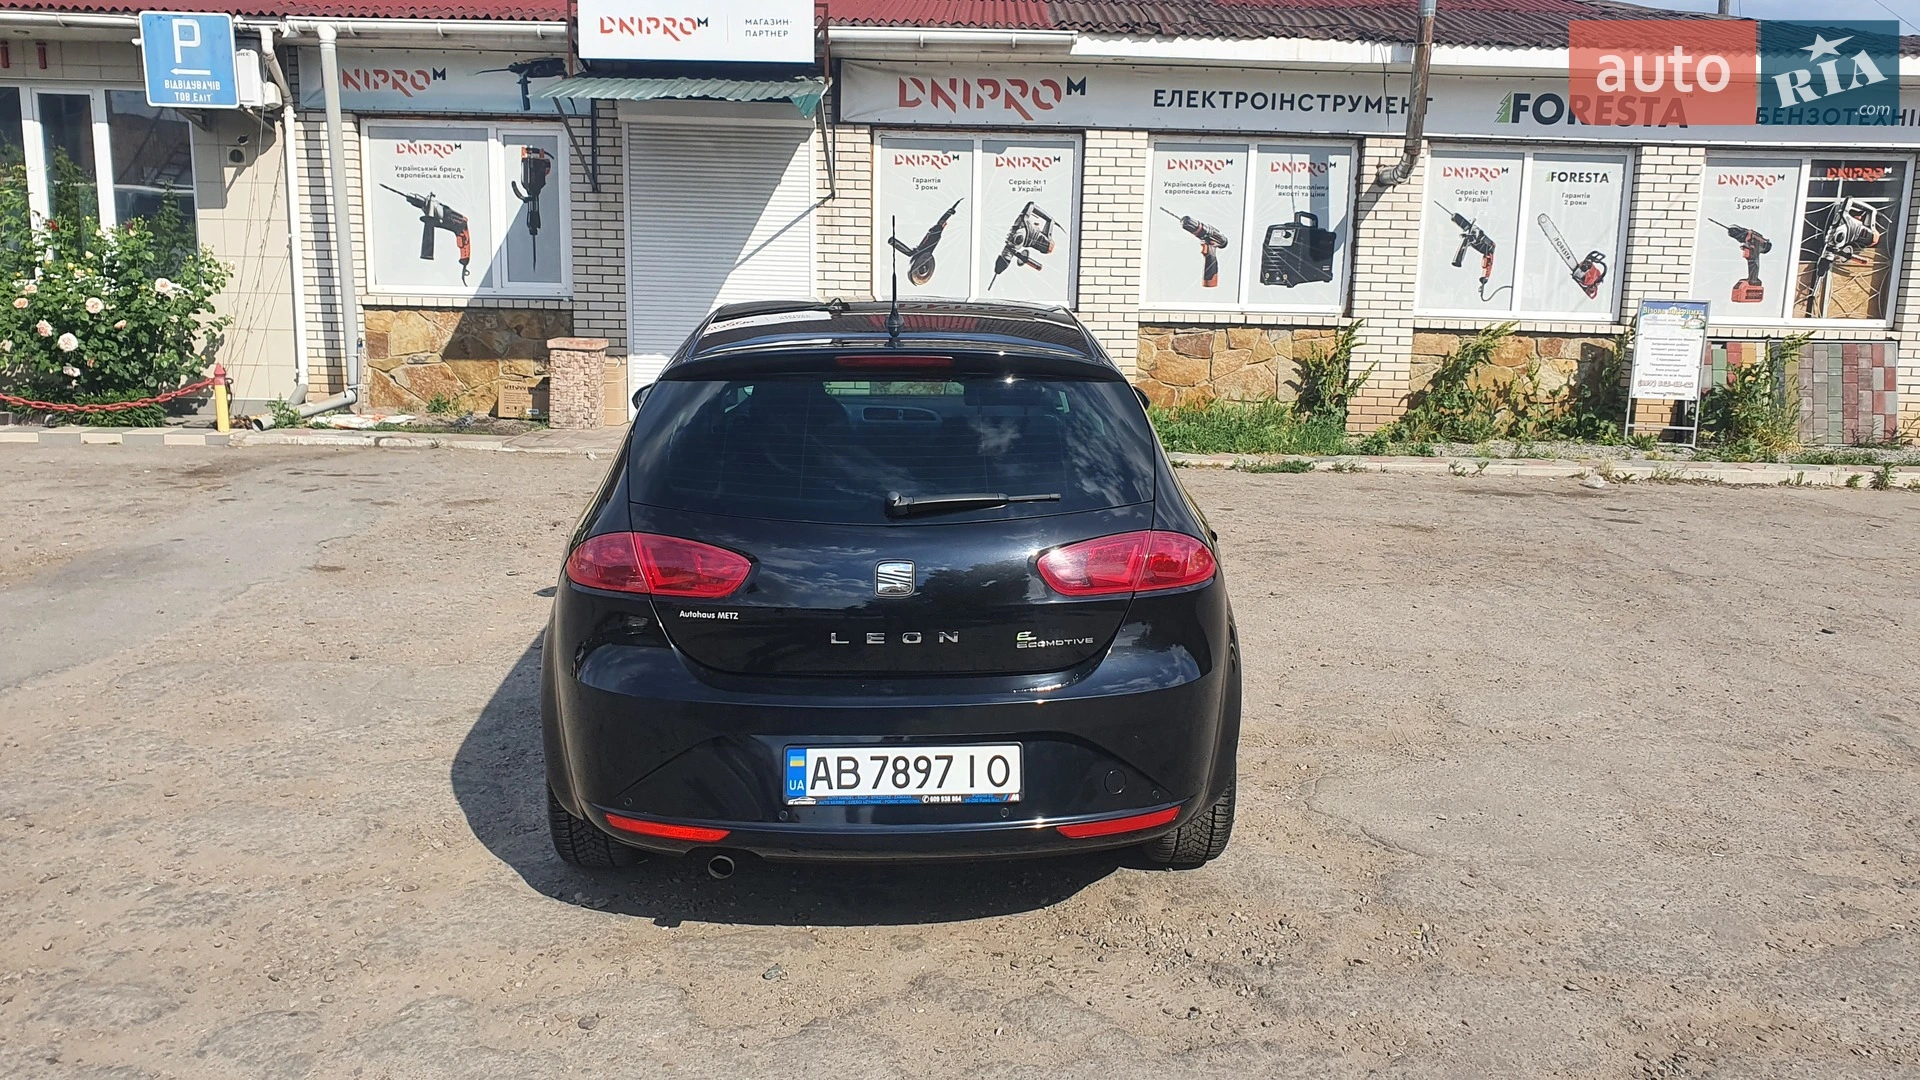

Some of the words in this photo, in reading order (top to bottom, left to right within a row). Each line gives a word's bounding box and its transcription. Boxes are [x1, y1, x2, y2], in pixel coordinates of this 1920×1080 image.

[745, 29, 789, 38] ПАРТНЕР
[172, 18, 201, 64] P
[164, 79, 221, 91] ВІДВІДУВАЧІВ
[174, 92, 190, 102] ТОВ
[439, 165, 462, 173] бренд
[1008, 179, 1032, 187] Сервіс
[1208, 181, 1231, 190] бренд
[679, 610, 716, 619] Autohaus
[717, 611, 739, 620] METZ
[829, 631, 960, 645] LEON
[810, 756, 861, 790] AB
[870, 755, 954, 790] 7897
[789, 779, 805, 791] UA
